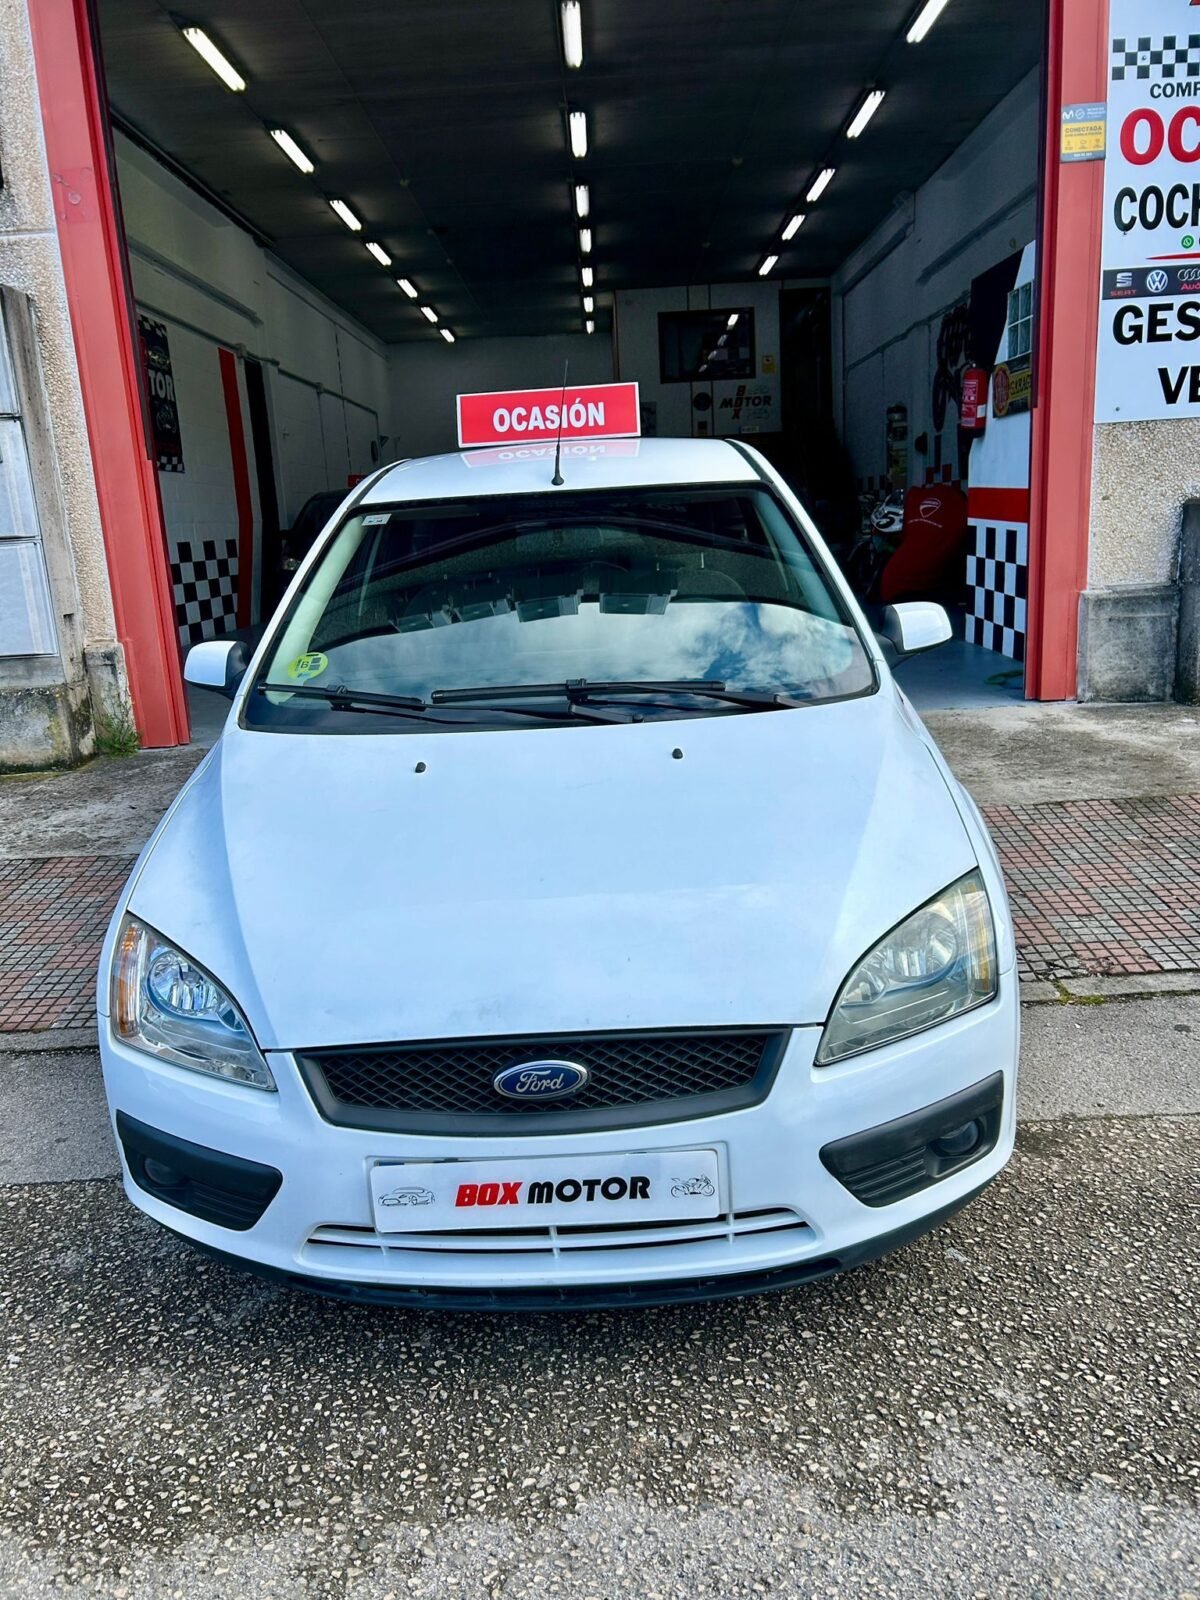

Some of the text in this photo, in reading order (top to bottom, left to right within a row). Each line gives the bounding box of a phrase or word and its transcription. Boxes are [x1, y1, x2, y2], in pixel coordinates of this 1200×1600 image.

[1119, 106, 1200, 165] OC
[1113, 301, 1200, 345] GES
[493, 398, 605, 433] OCASIÓN
[516, 1070, 565, 1092] Ford
[455, 1175, 651, 1207] BOX MOTOR
